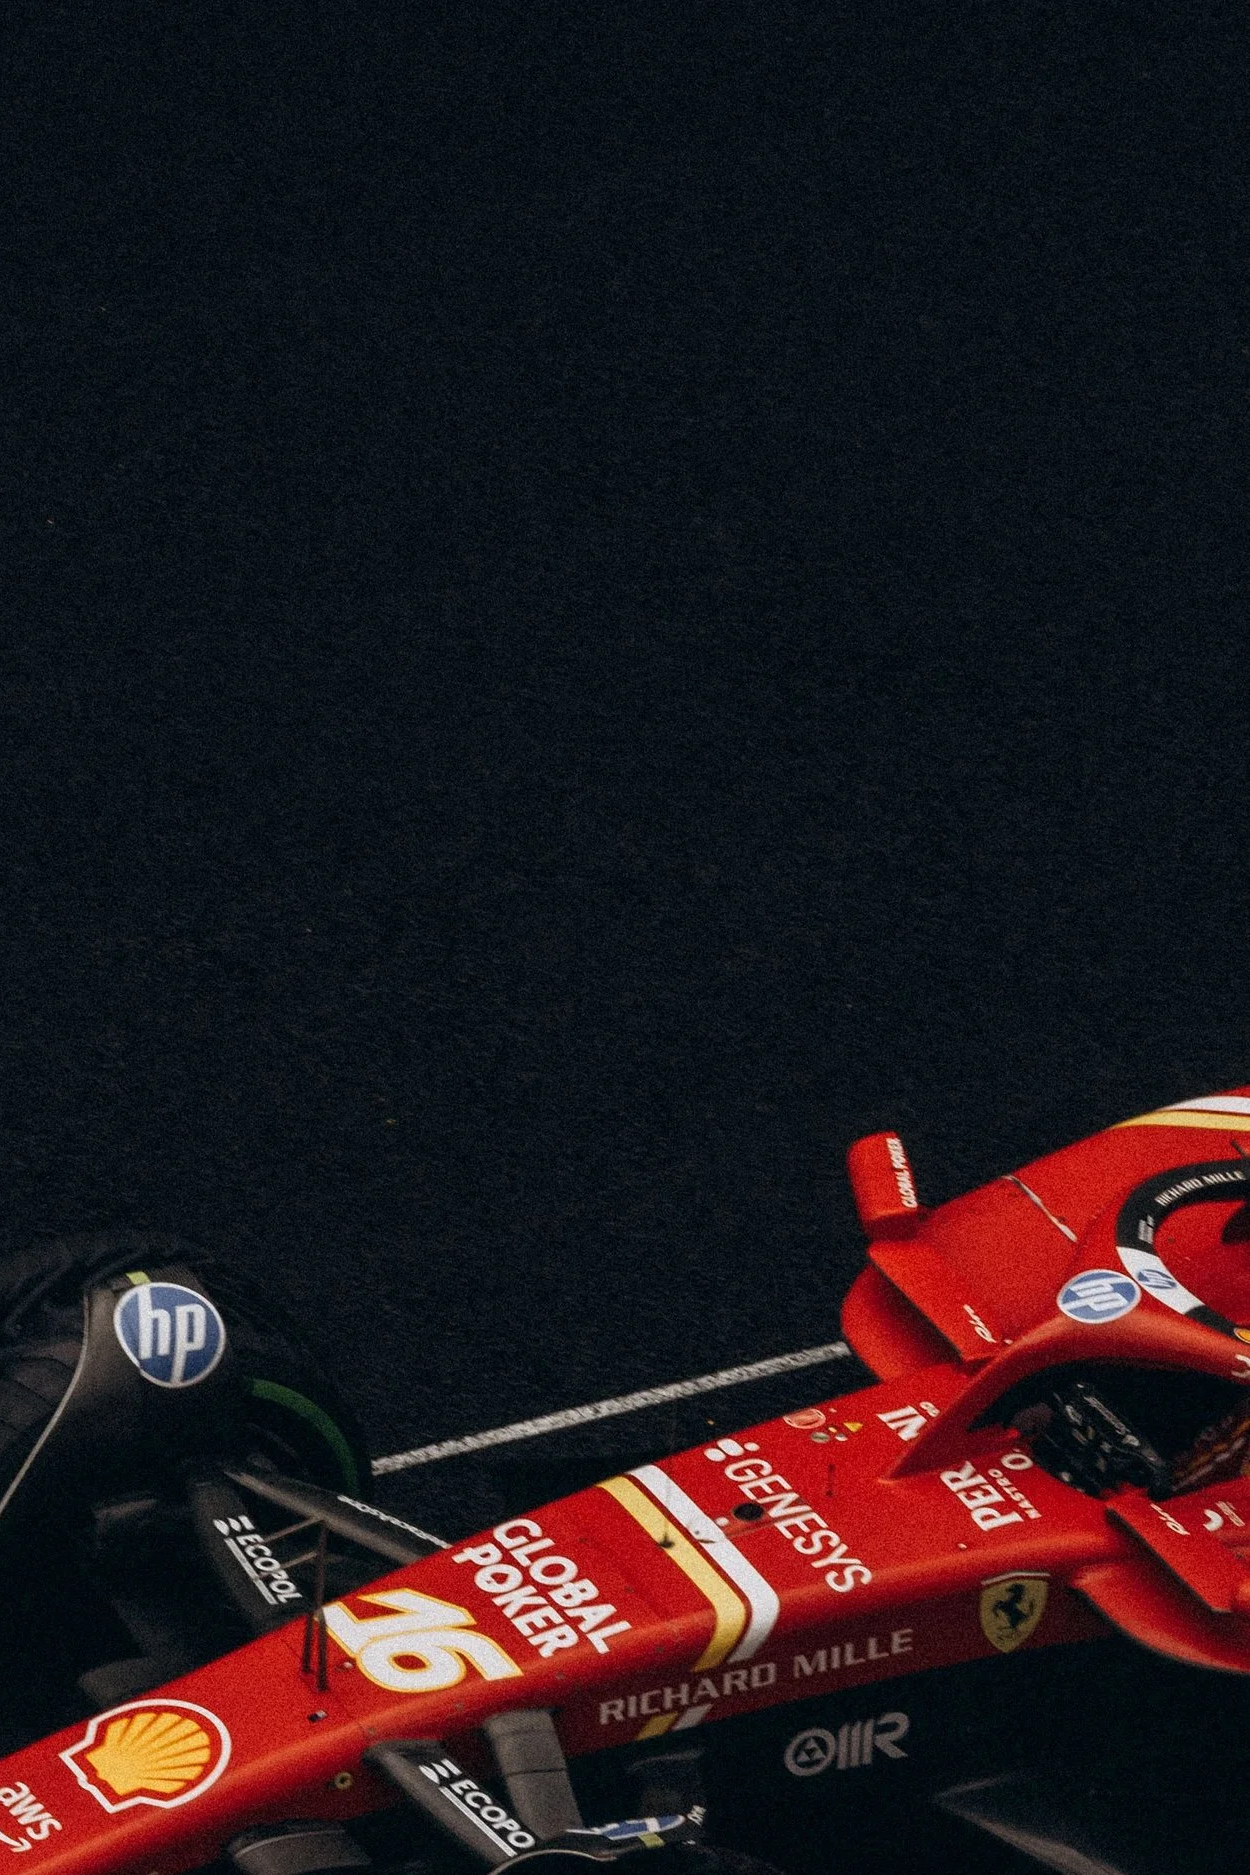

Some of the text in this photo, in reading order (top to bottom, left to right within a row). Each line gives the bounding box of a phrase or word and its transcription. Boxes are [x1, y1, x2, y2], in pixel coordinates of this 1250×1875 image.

[1154, 1178, 1204, 1207] RICHARD
[137, 1284, 207, 1385] hp
[1062, 1277, 1134, 1312] hp
[724, 1458, 873, 1593] GENESYS
[987, 1468, 1043, 1520] NASTRO
[235, 1533, 304, 1604] ECOPOL
[451, 1542, 579, 1658] POKER
[493, 1518, 632, 1655] GLOBAL
[314, 1586, 525, 1694] 16
[599, 1627, 914, 1726] RICHARD MILLE
[449, 1779, 537, 1850] ECOPO
